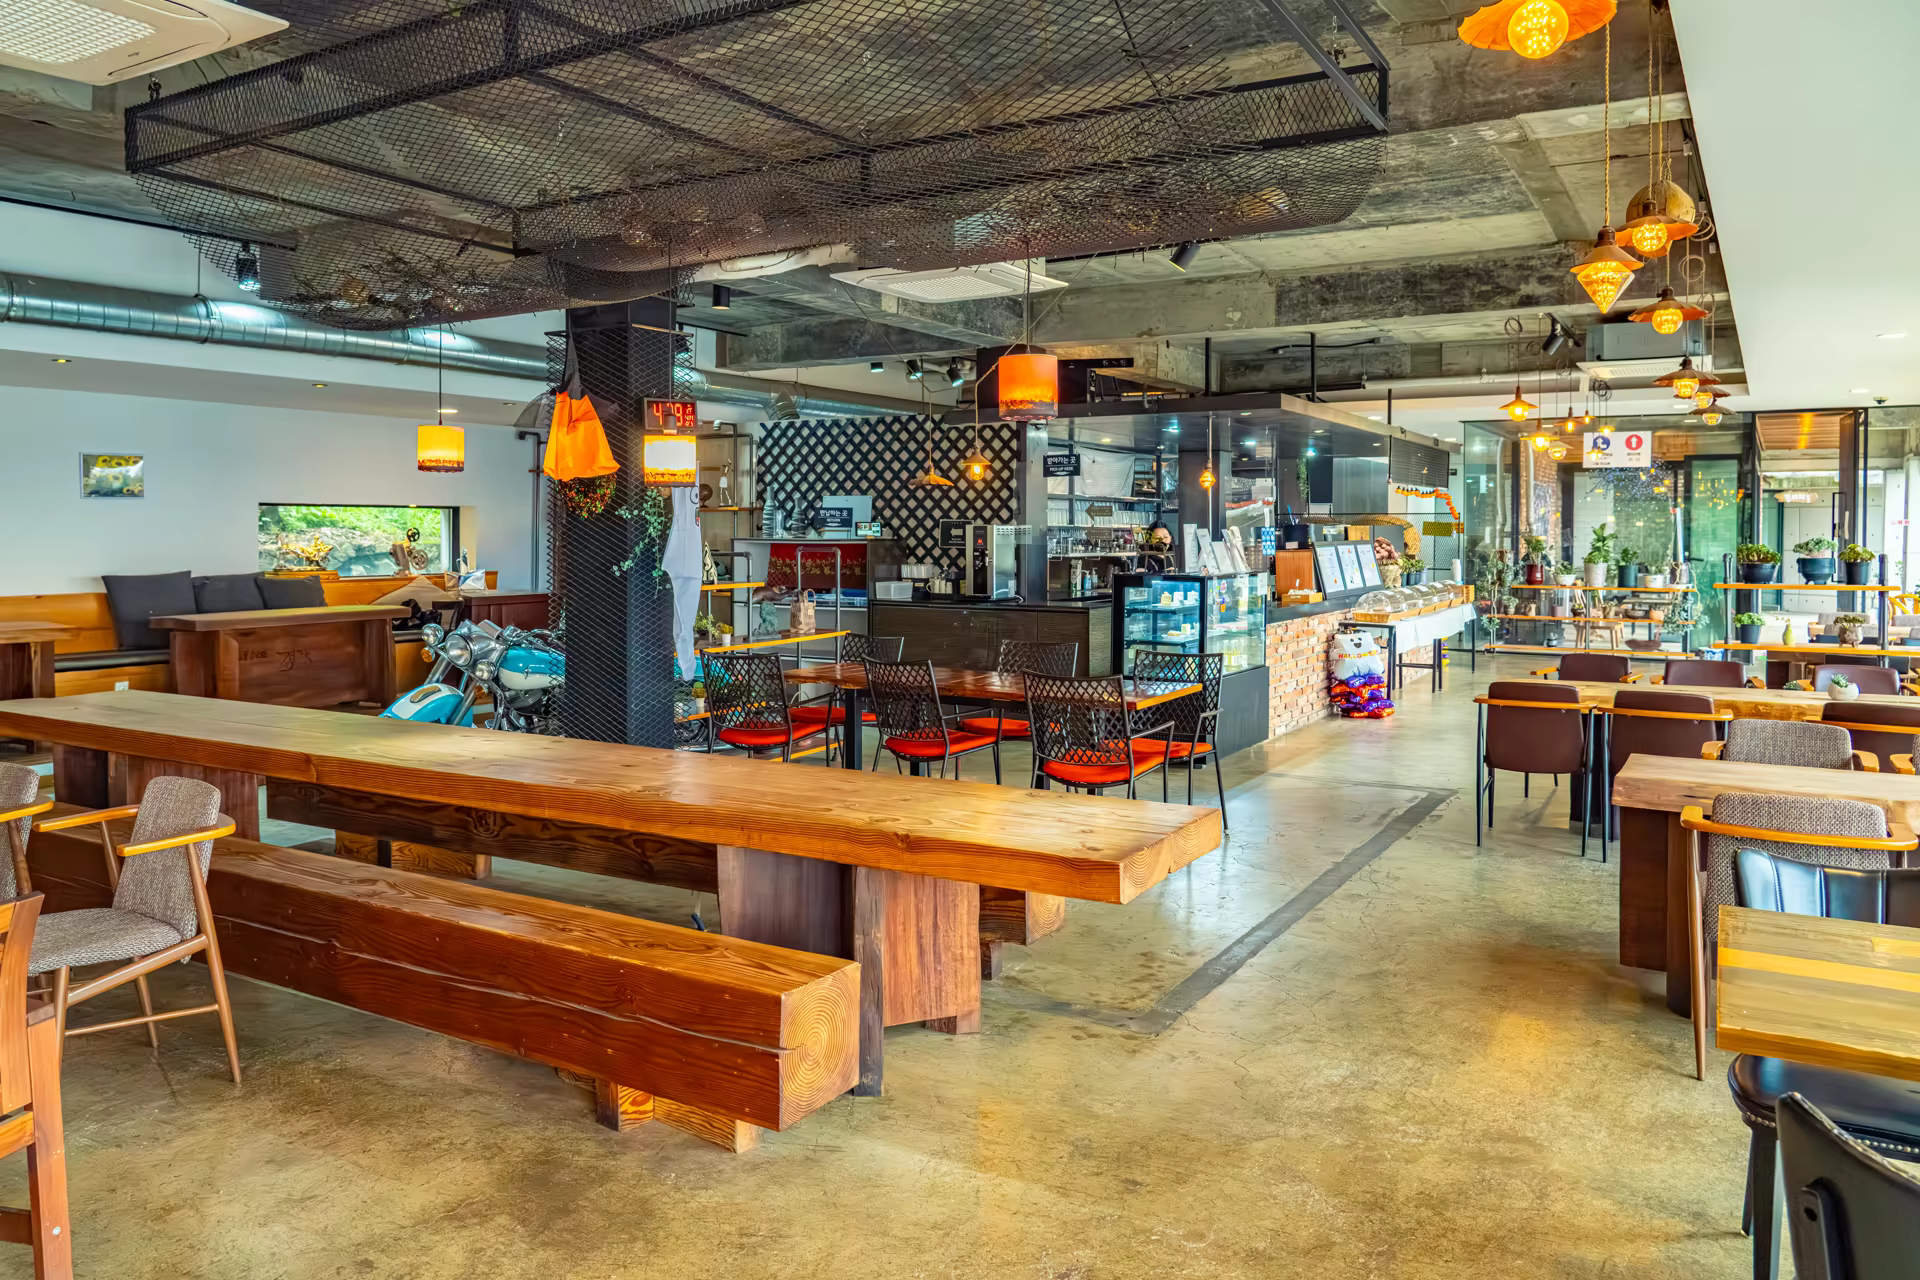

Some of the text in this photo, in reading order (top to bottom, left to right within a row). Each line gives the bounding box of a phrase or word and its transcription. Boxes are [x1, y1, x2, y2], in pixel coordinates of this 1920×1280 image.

[1047, 455, 1076, 465] 받아가는 곳
[820, 509, 848, 517] 반납하는 곳
